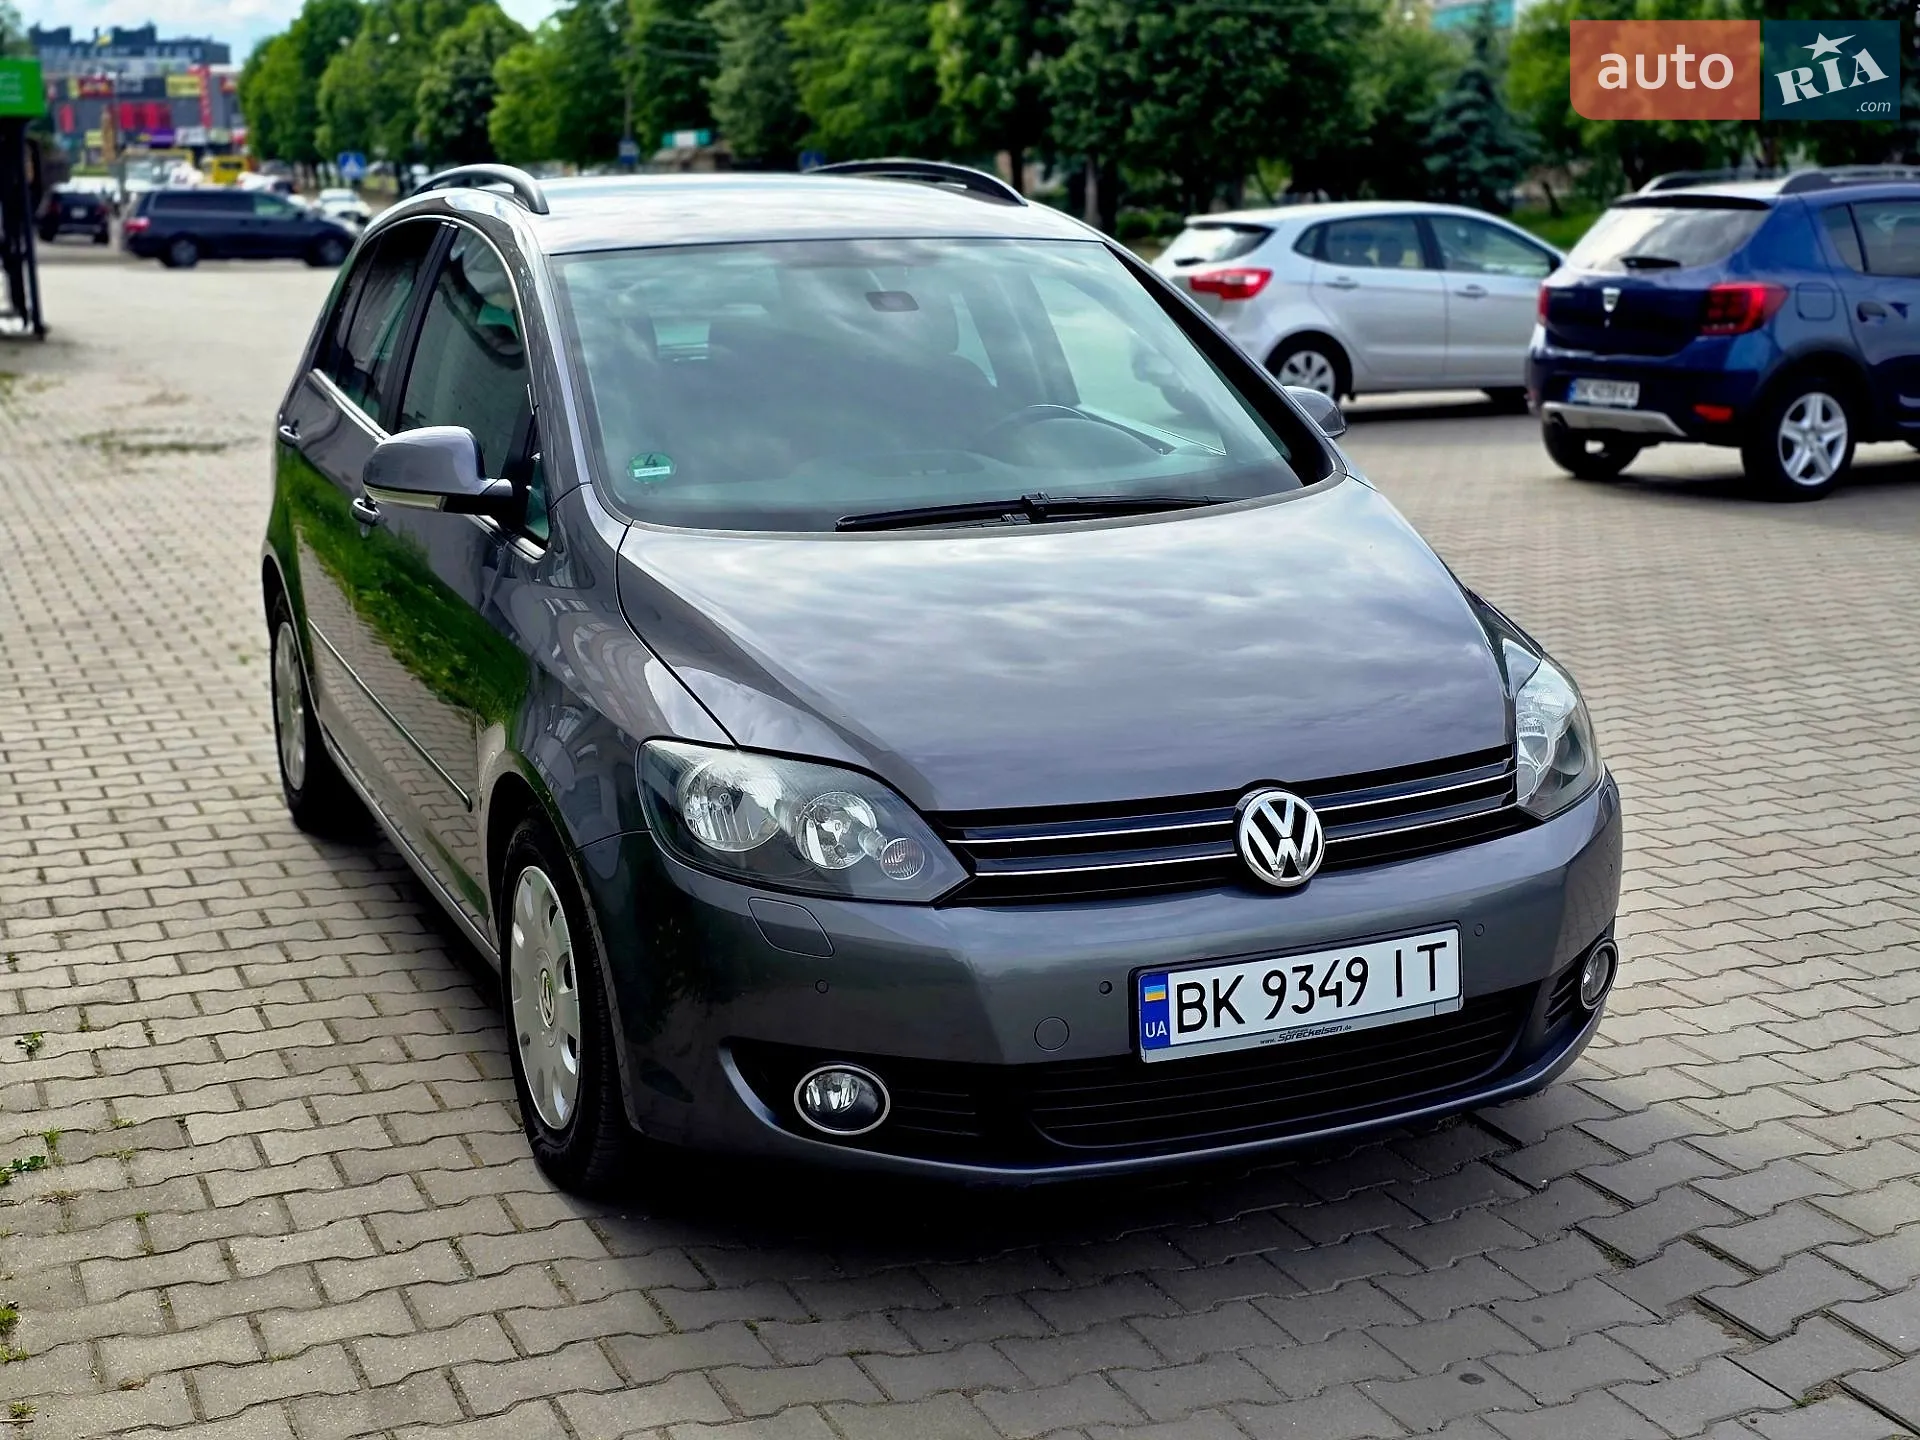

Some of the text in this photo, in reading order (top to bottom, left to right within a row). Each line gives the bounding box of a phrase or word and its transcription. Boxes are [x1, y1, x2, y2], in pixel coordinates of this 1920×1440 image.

[1175, 973, 1246, 1034] BK
[1261, 956, 1369, 1021] 9349
[1144, 1019, 1169, 1039] UA
